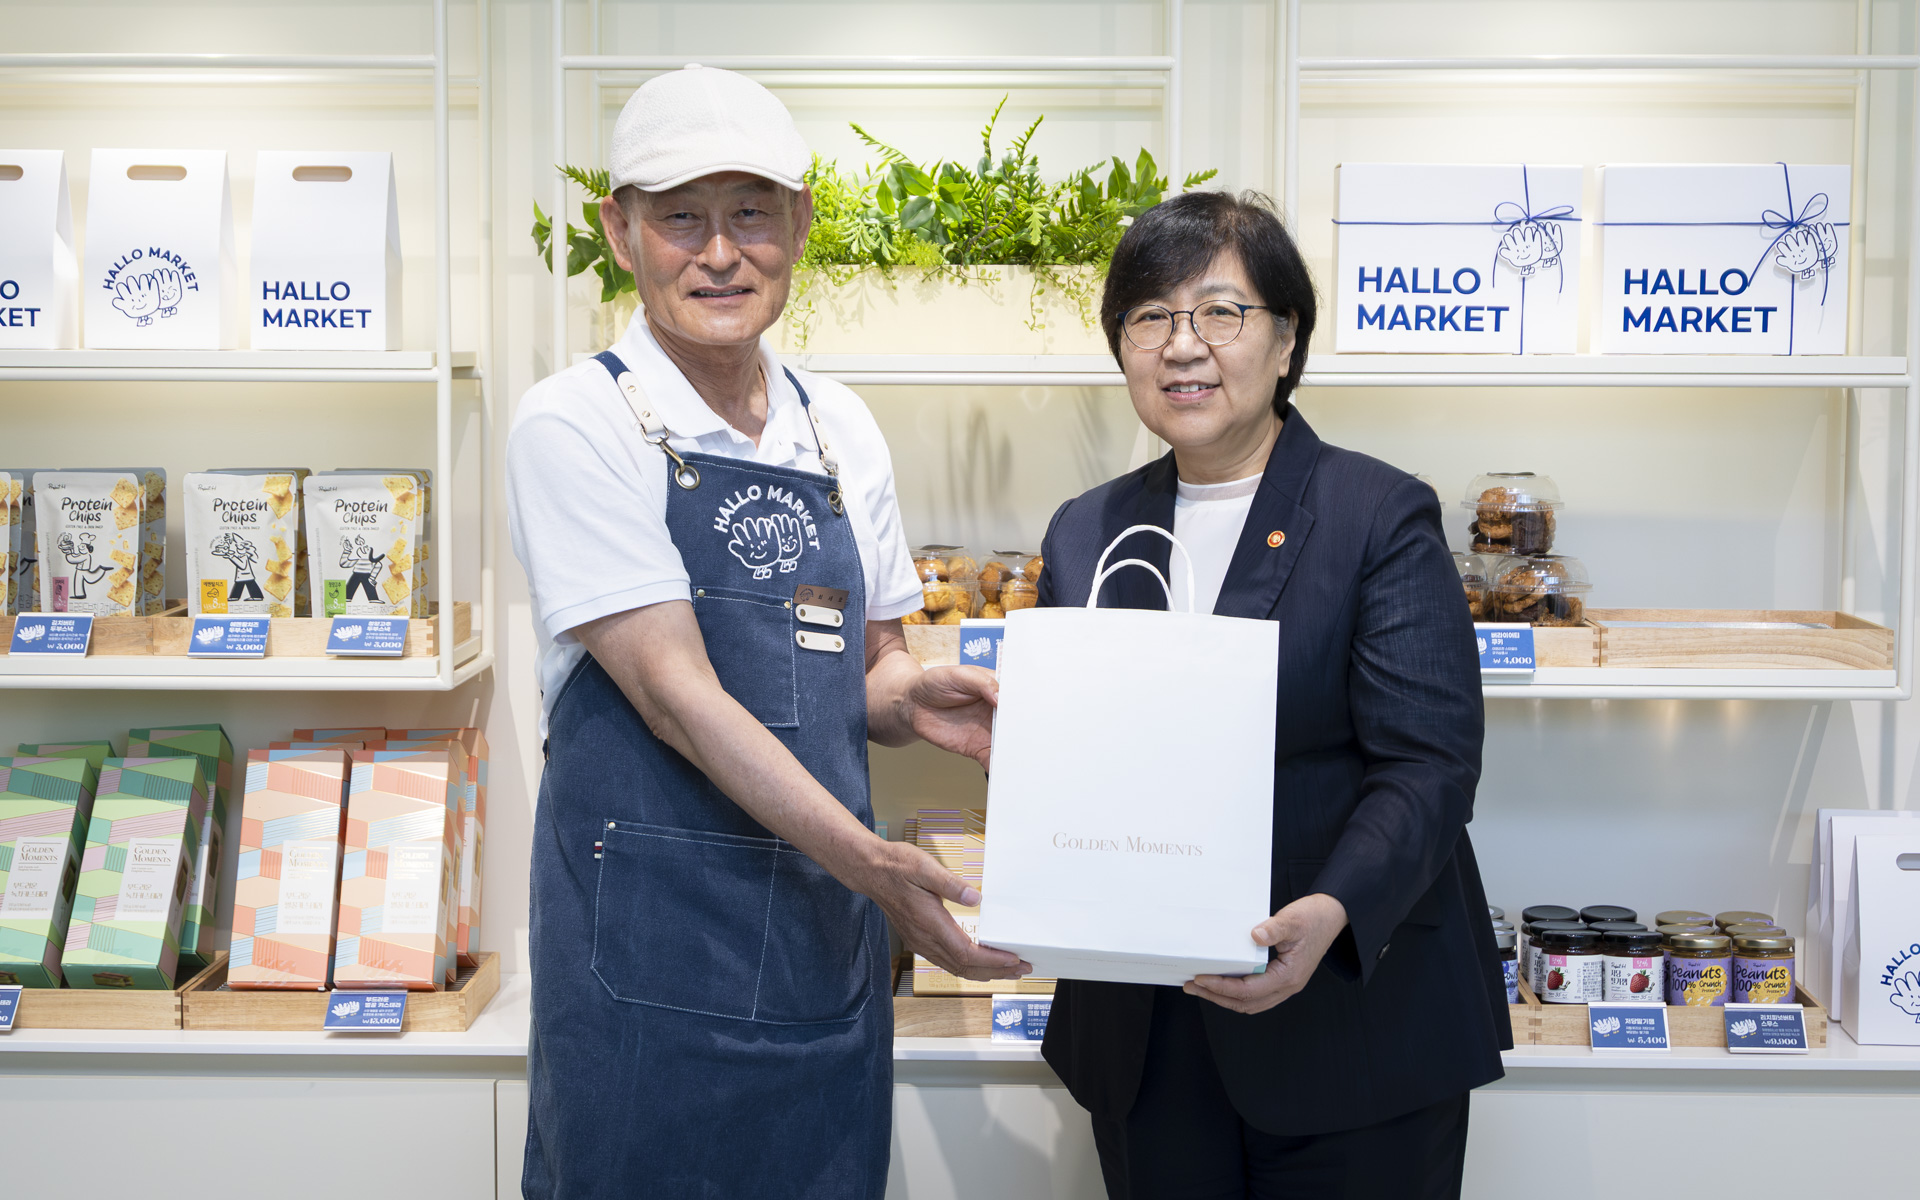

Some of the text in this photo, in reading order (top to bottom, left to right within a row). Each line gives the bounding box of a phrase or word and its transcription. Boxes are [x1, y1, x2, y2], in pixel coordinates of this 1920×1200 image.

[102, 246, 199, 292] HALLO MARKET
[1358, 266, 1481, 294] HALLO
[1624, 268, 1749, 296] HALLO
[262, 281, 350, 301] HALLO
[262, 308, 372, 328] MARKET
[1356, 304, 1510, 332] MARKET
[1622, 306, 1778, 334] MARKET
[61, 496, 113, 511] Protein
[212, 498, 268, 512] Protein
[334, 498, 388, 512] Protein
[69, 510, 101, 524] Chips
[222, 511, 257, 525] Chips
[343, 512, 376, 526] Chips
[714, 485, 820, 550] HALLO MARKET
[1880, 943, 1920, 986] HALLO
[1672, 965, 1722, 980] Peanuts
[1736, 965, 1786, 980] Peanuts
[1672, 979, 1722, 991] 100% Crunch
[1736, 979, 1787, 992] 100% Crunch
